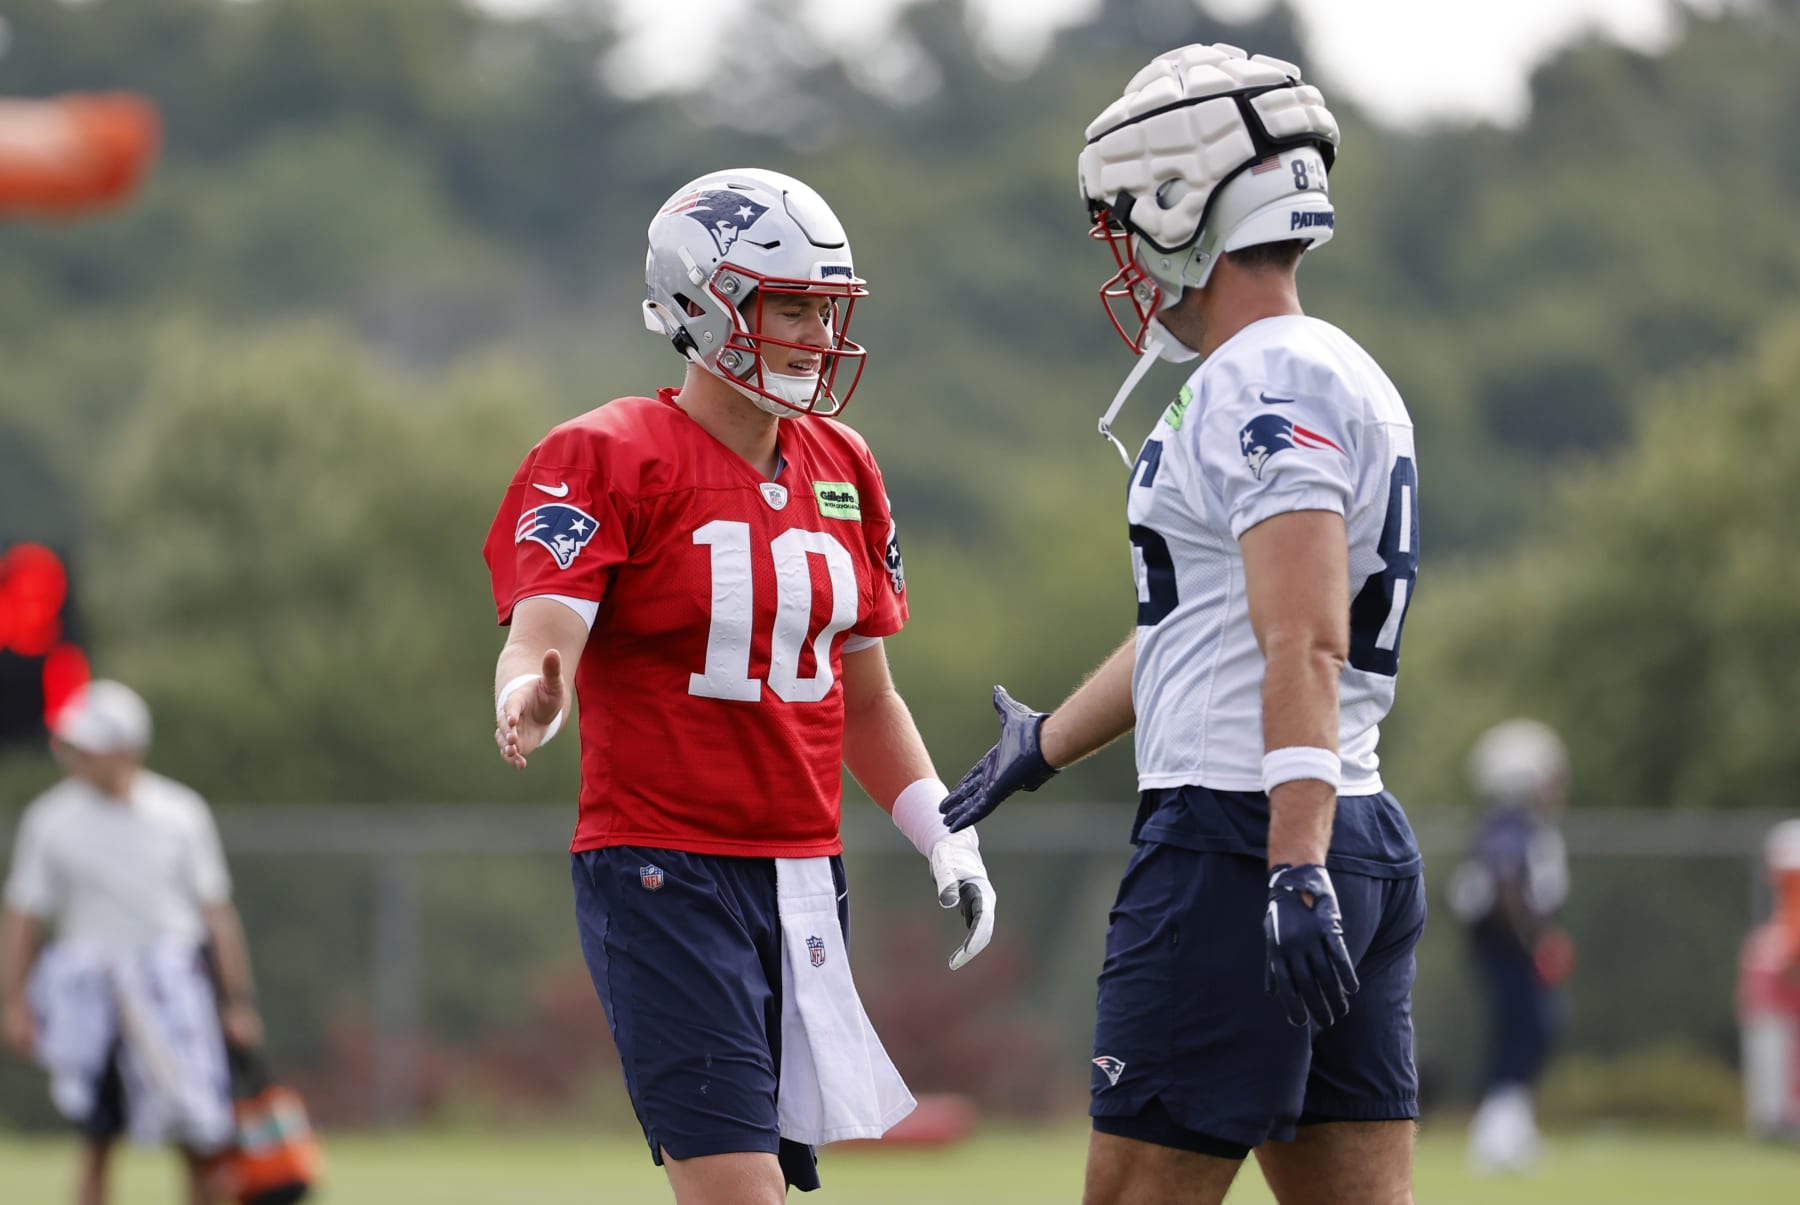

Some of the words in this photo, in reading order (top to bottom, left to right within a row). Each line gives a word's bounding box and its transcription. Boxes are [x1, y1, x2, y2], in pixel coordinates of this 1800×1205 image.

[820, 490, 855, 503] Gillette
[688, 520, 858, 703] 10
[643, 875, 662, 889] NFL
